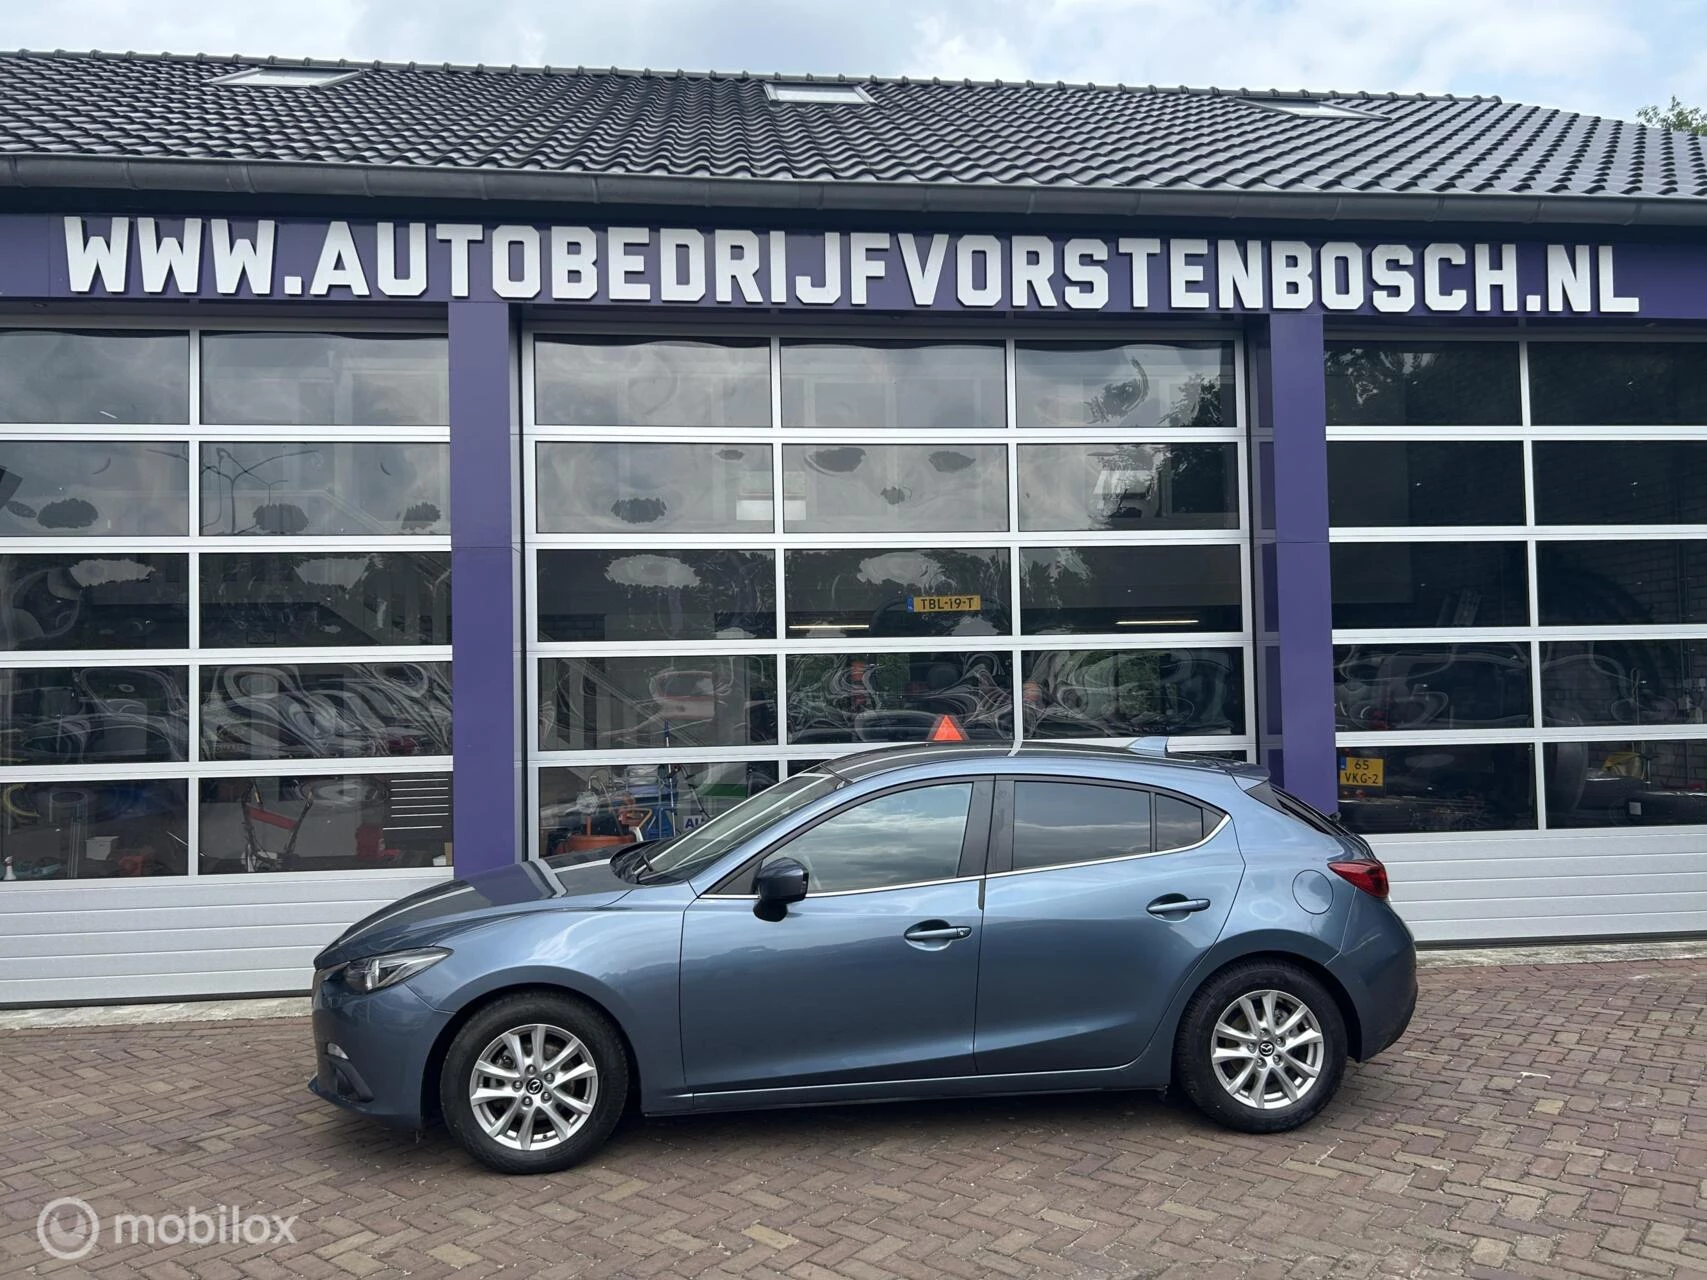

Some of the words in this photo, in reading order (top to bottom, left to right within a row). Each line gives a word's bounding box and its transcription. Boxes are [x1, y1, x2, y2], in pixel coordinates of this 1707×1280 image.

[64, 216, 1640, 313] WWW.AUTOBEDRIJFVORSTENBOSCH.NL
[920, 597, 975, 610] TBL-19-T
[1354, 760, 1369, 770] 65
[1345, 772, 1378, 785] VKG-2
